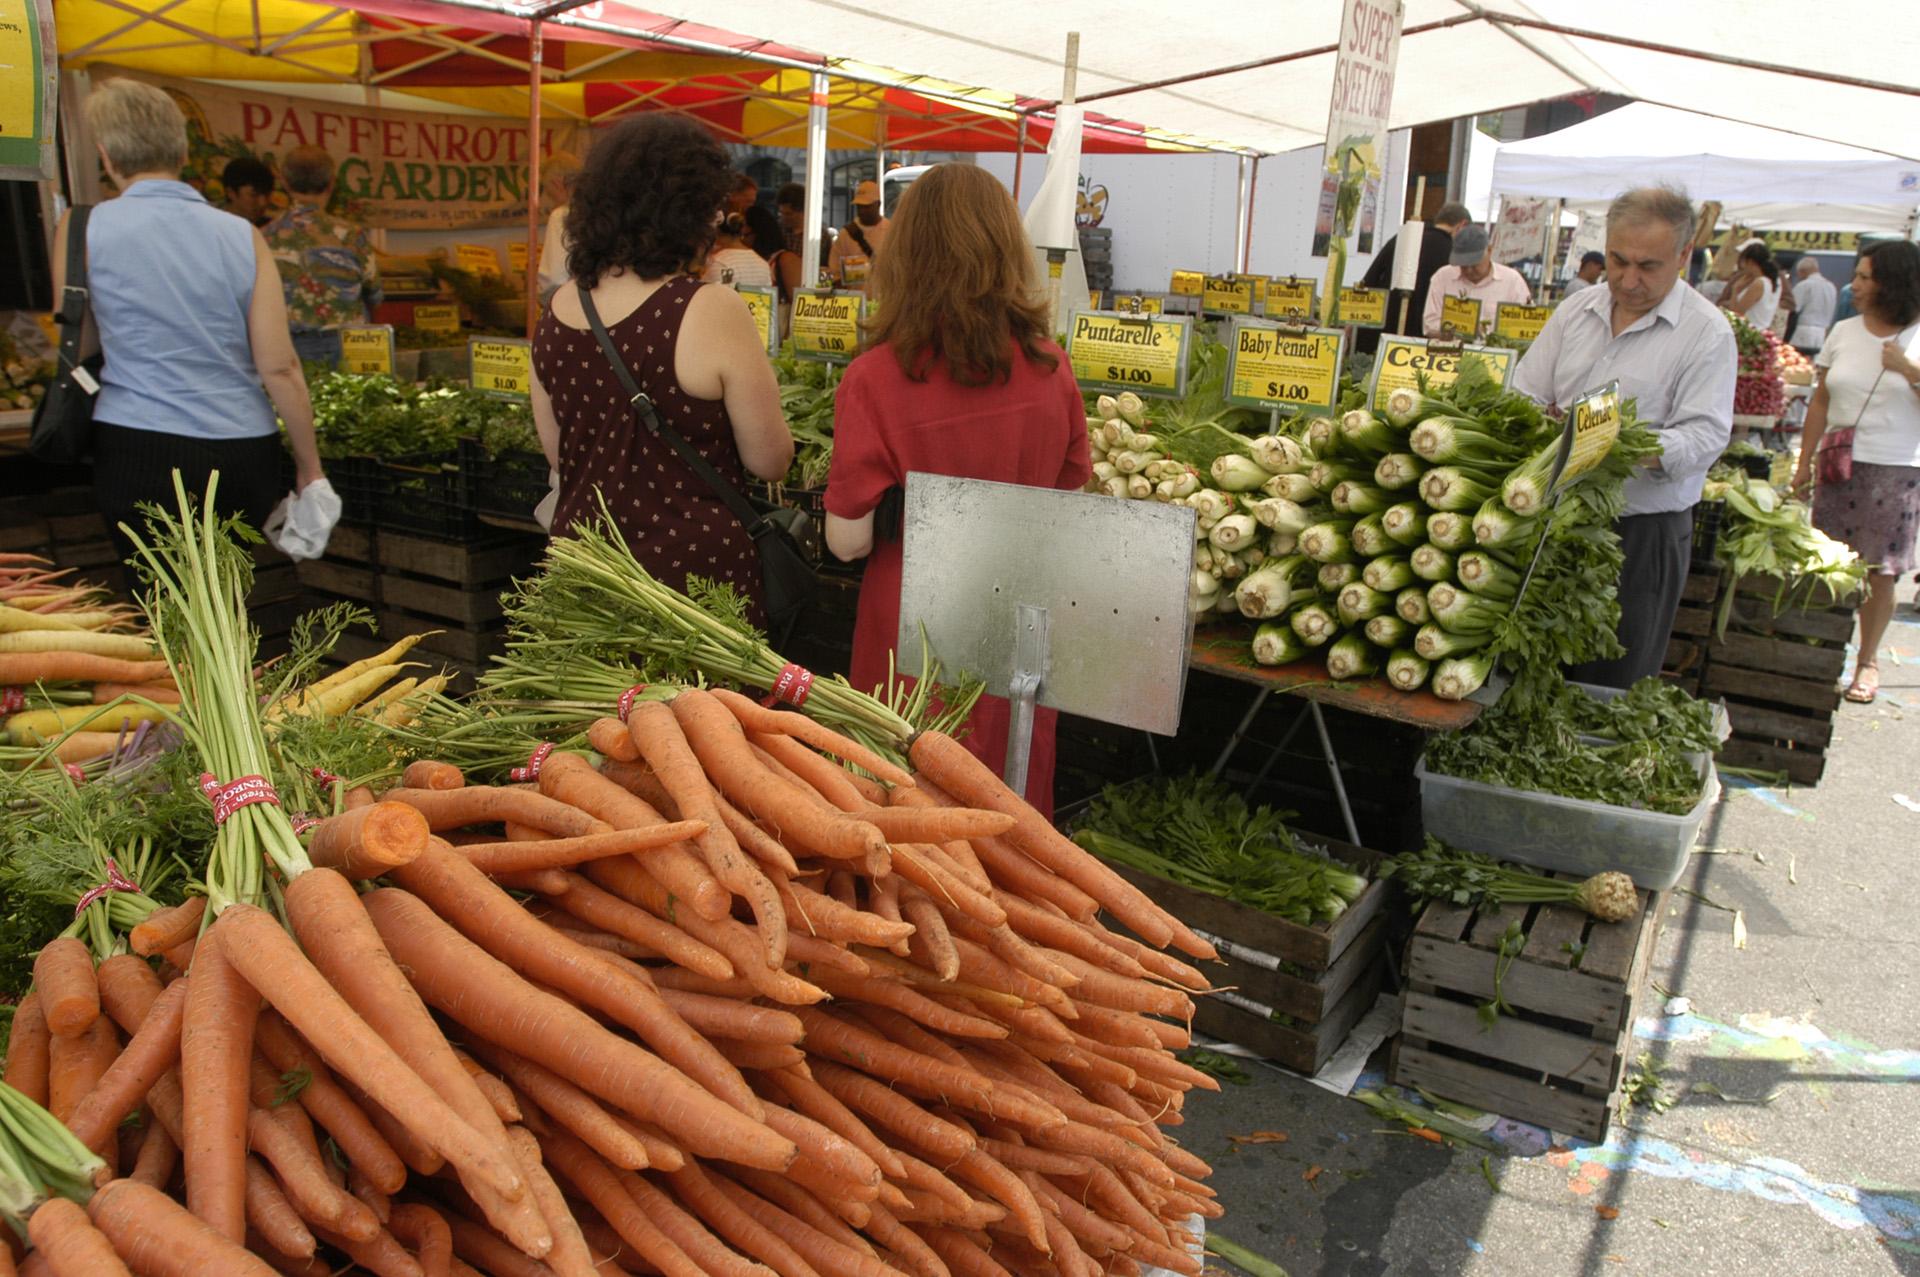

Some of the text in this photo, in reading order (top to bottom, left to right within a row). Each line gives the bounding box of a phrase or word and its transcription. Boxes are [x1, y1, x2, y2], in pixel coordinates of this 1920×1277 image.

[1349, 1, 1395, 65] SUPER
[1334, 57, 1395, 121] SWEET CORN
[241, 102, 554, 163] PAFFENROTH
[795, 297, 849, 319] Dandelion
[343, 331, 382, 346] Parsley
[1075, 317, 1162, 347] Puntarelle
[477, 343, 513, 355] Curly
[818, 336, 845, 351] $1.00
[1239, 331, 1320, 361] Baby Fennel
[474, 350, 521, 363] Parsley
[493, 377, 517, 390] $1.00
[1107, 366, 1152, 383] $1.00
[1266, 382, 1309, 401] $1.00
